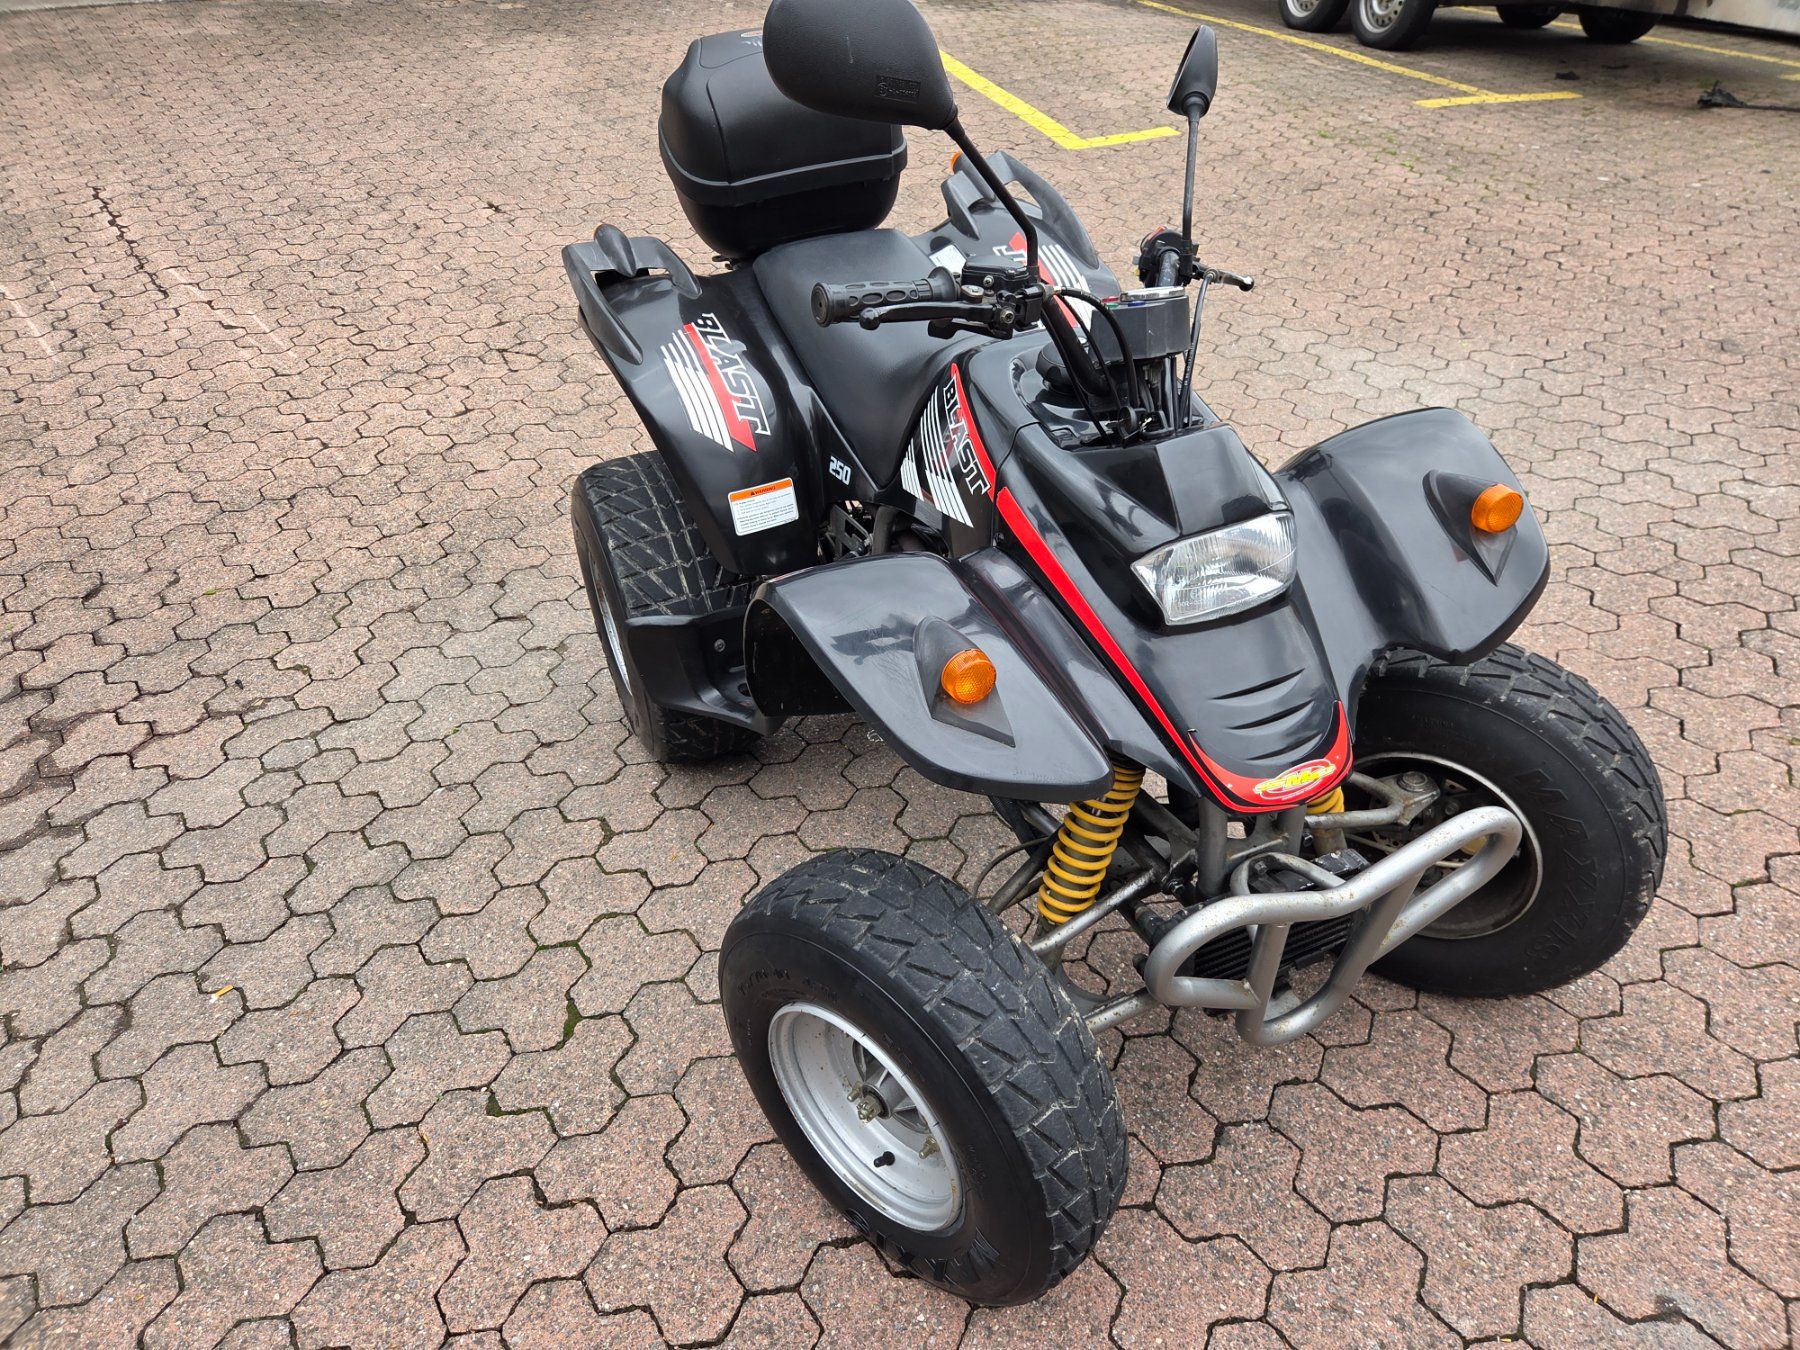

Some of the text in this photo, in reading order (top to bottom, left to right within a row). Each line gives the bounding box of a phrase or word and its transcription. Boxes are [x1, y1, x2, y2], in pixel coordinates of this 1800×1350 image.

[697, 312, 771, 436] BLAST
[829, 455, 851, 485] 250
[943, 375, 991, 495] BLAST
